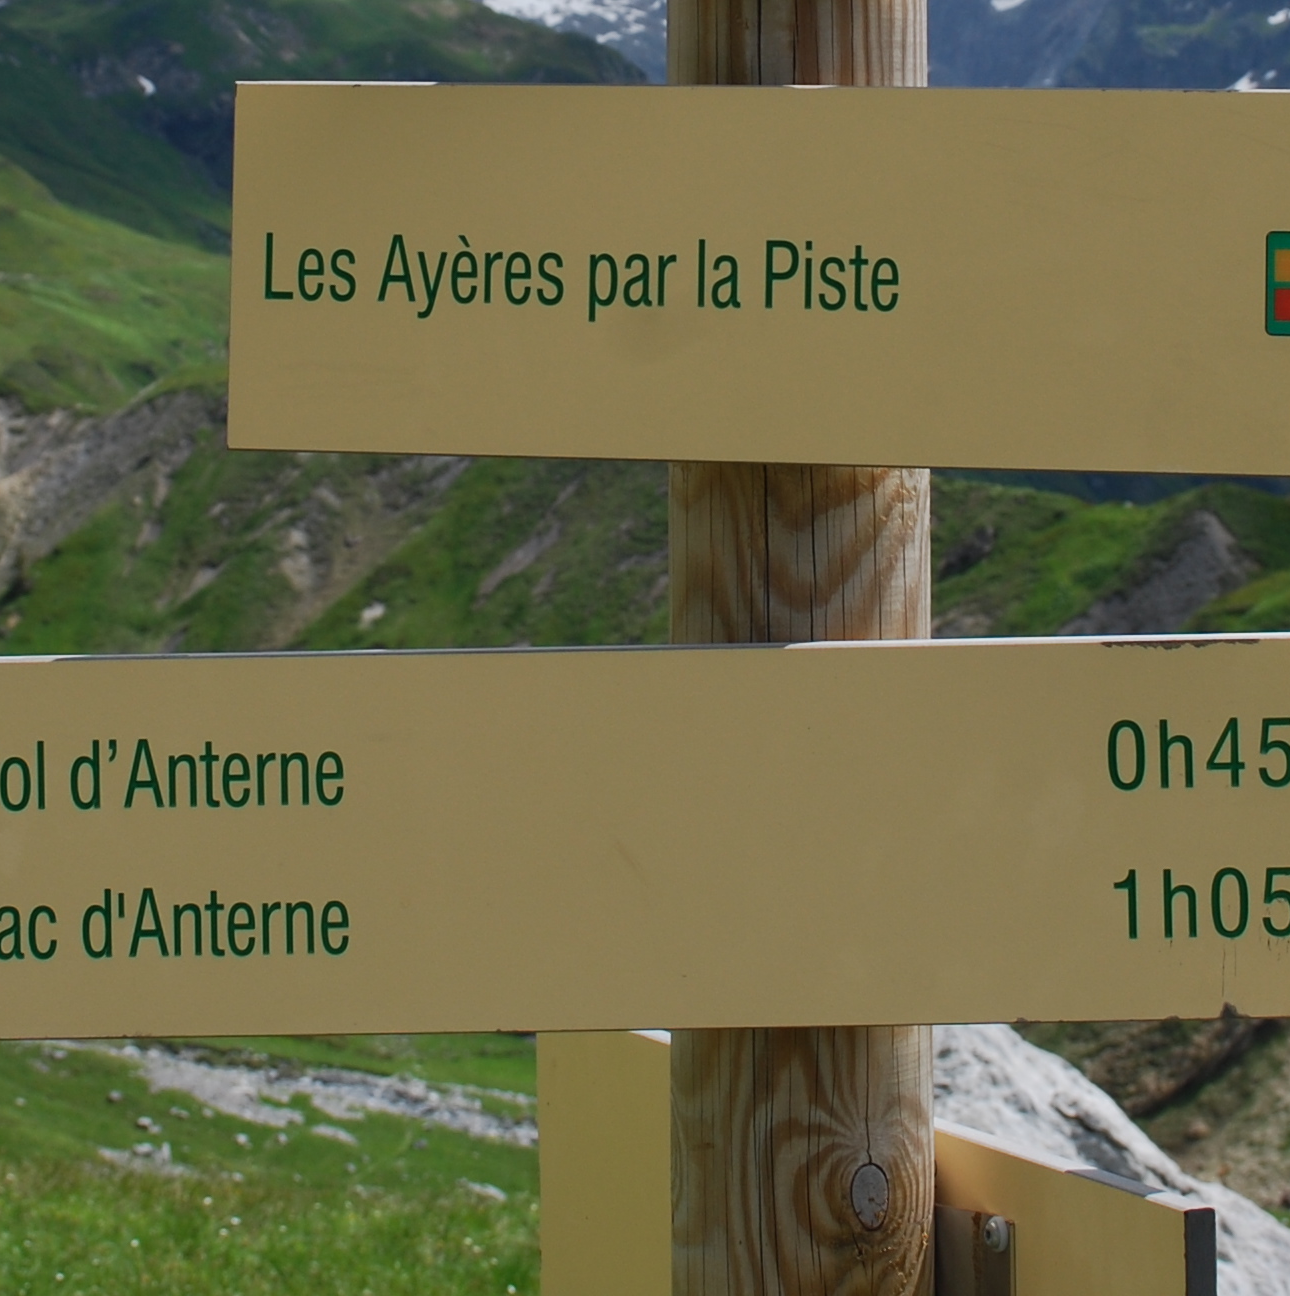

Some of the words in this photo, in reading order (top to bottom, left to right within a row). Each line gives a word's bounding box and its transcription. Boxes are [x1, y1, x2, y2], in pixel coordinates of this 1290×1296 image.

[264, 231, 357, 303] Les
[377, 234, 564, 320] Ayères
[588, 253, 678, 323] par
[697, 238, 742, 310] la
[764, 239, 900, 313] Piste
[81, 887, 350, 960] d'Anterne
